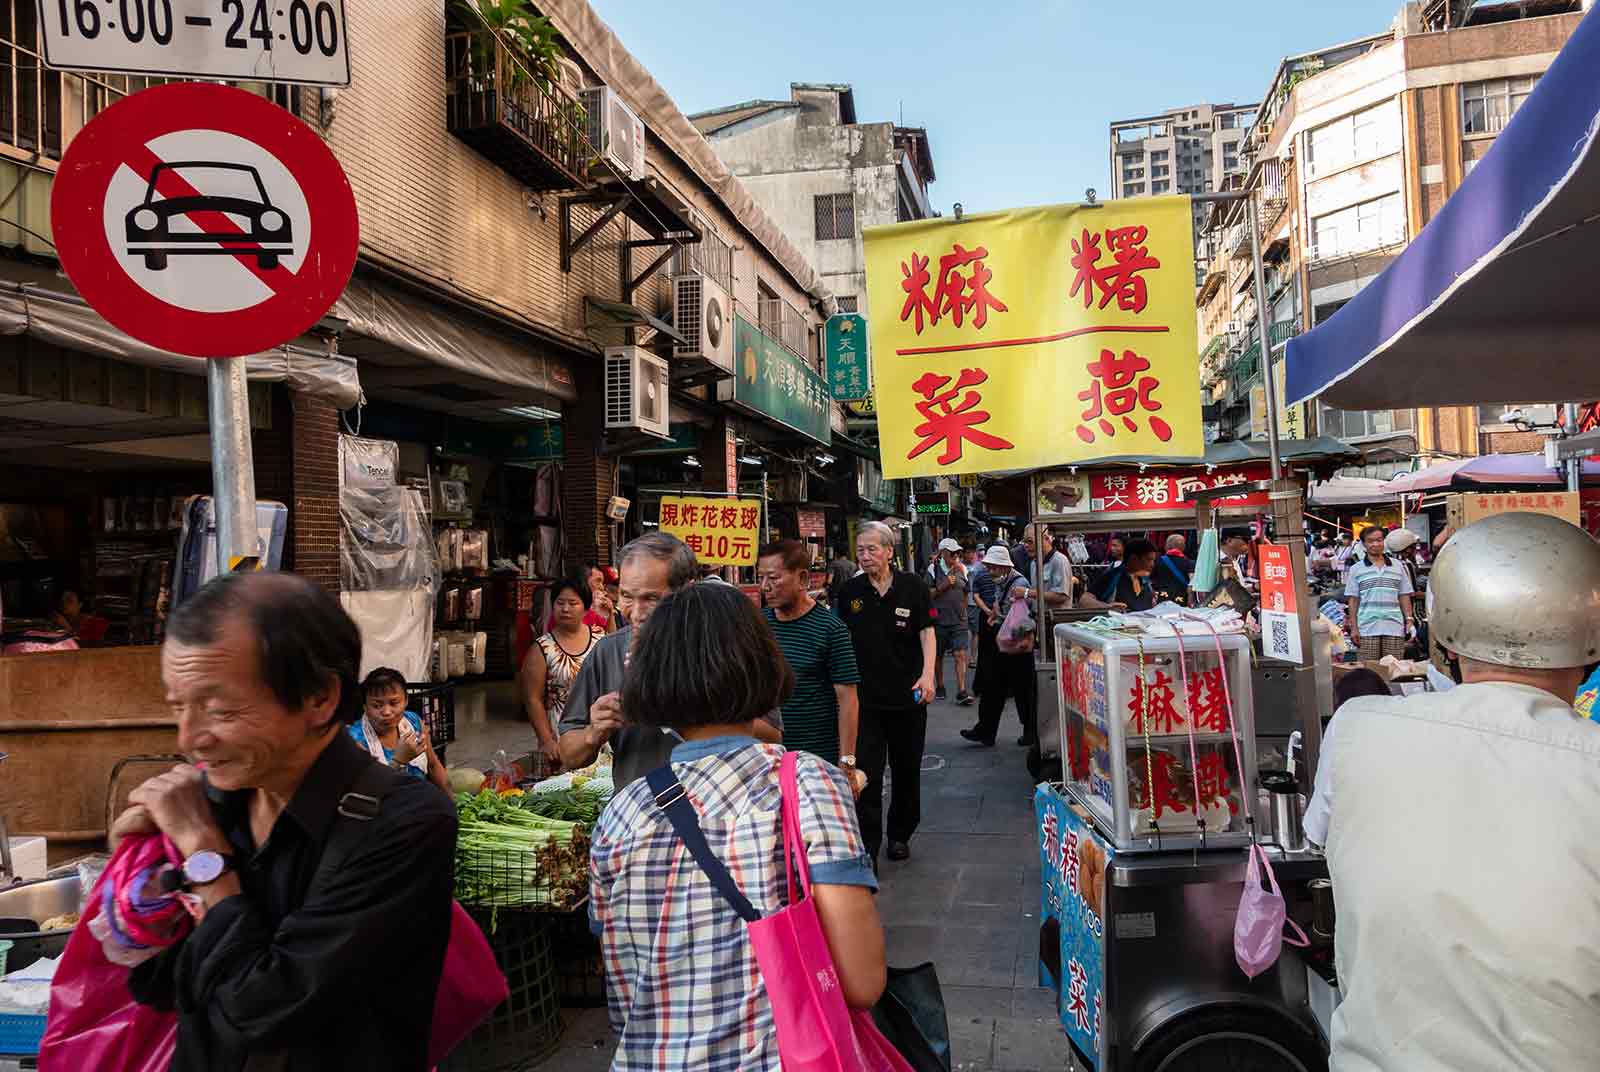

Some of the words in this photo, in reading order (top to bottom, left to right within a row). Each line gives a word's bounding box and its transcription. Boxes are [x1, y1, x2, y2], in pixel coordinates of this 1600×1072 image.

[221, 0, 337, 57] 24:00
[661, 503, 758, 529] 現炸花枝球
